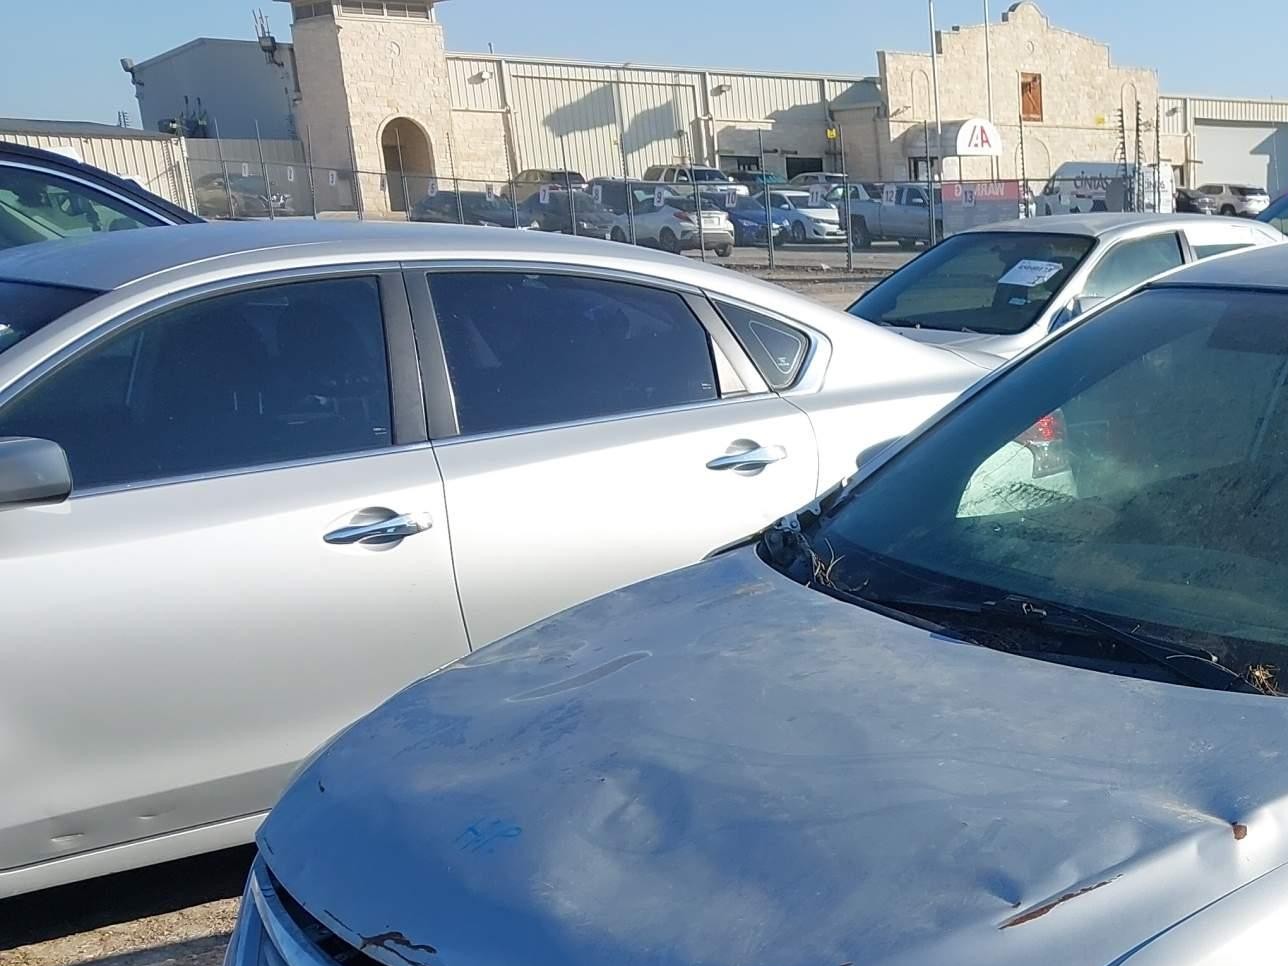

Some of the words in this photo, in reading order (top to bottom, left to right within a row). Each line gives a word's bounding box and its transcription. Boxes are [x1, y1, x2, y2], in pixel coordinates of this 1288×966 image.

[726, 190, 736, 205] 10
[885, 190, 895, 203] 12
[963, 190, 974, 203] 13
